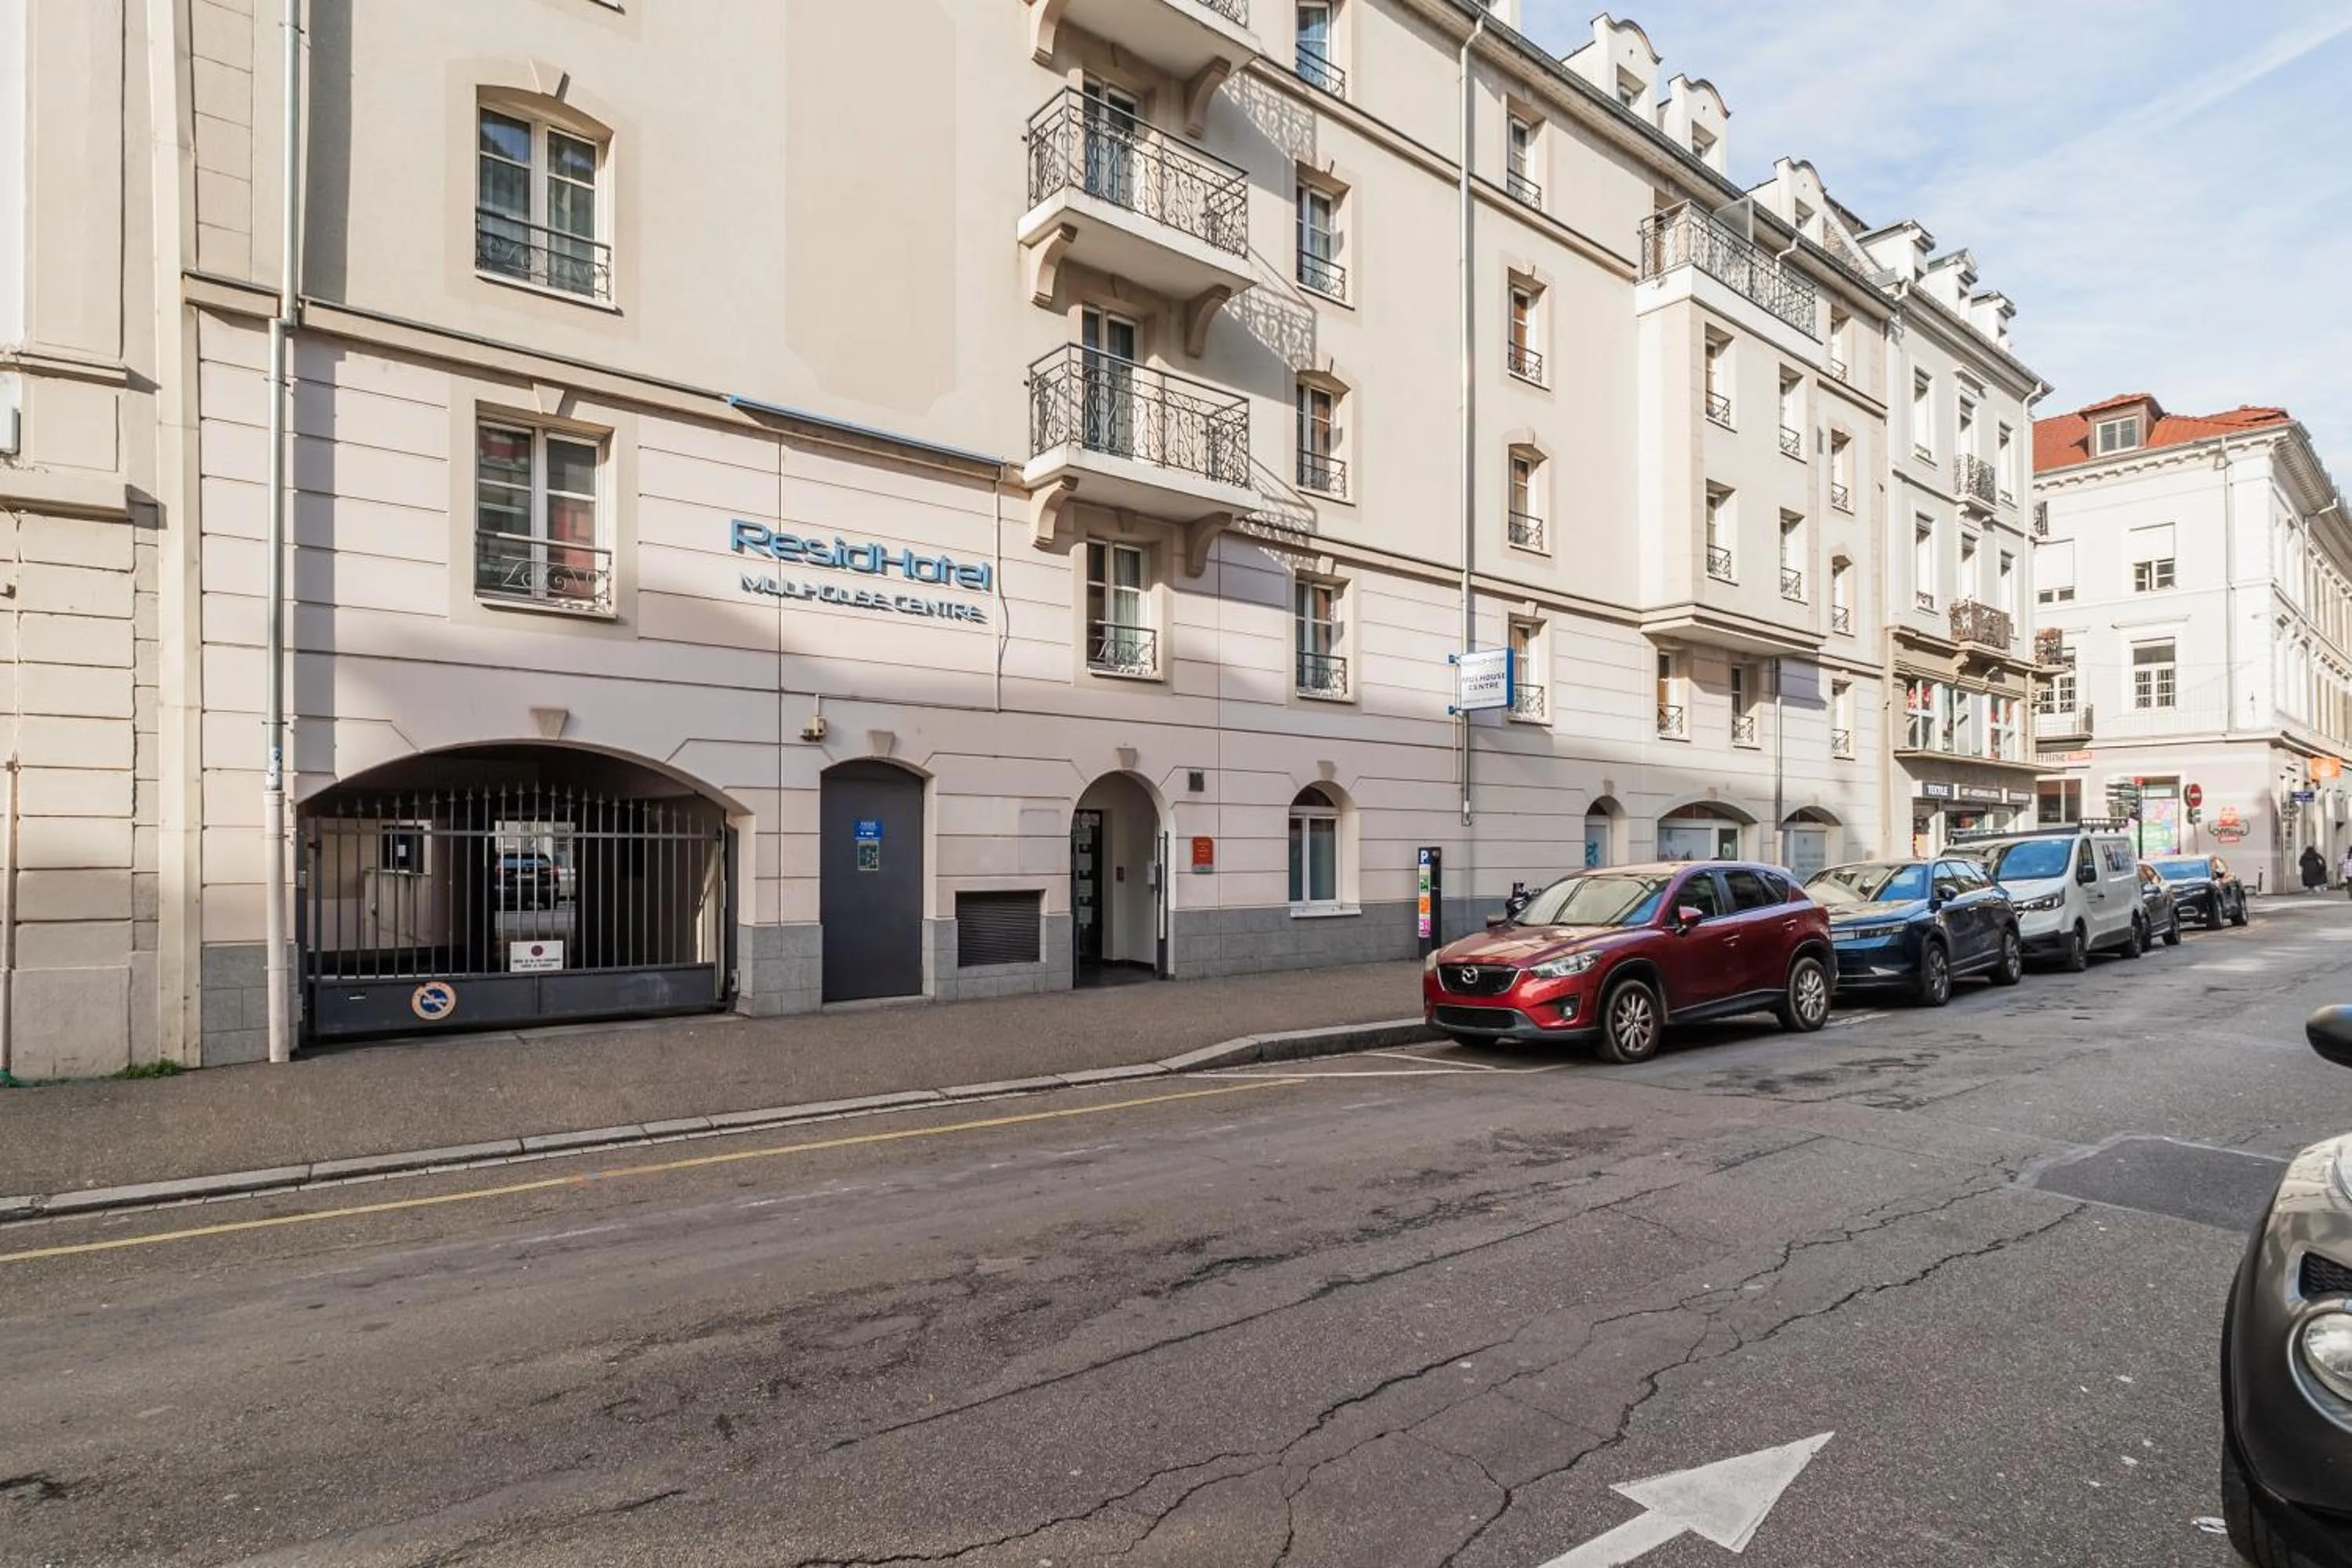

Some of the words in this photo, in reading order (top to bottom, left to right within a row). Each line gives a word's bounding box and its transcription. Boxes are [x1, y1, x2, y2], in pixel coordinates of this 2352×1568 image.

[730, 518, 993, 592] ResidHotel
[740, 573, 895, 612] MULHOUSE
[895, 593, 989, 624] CENTRE
[1462, 672, 1506, 684] MULHOUSE
[1468, 681, 1499, 691] CENTRE
[1926, 784, 1949, 796] TEXTILE
[1420, 849, 1429, 863] P
